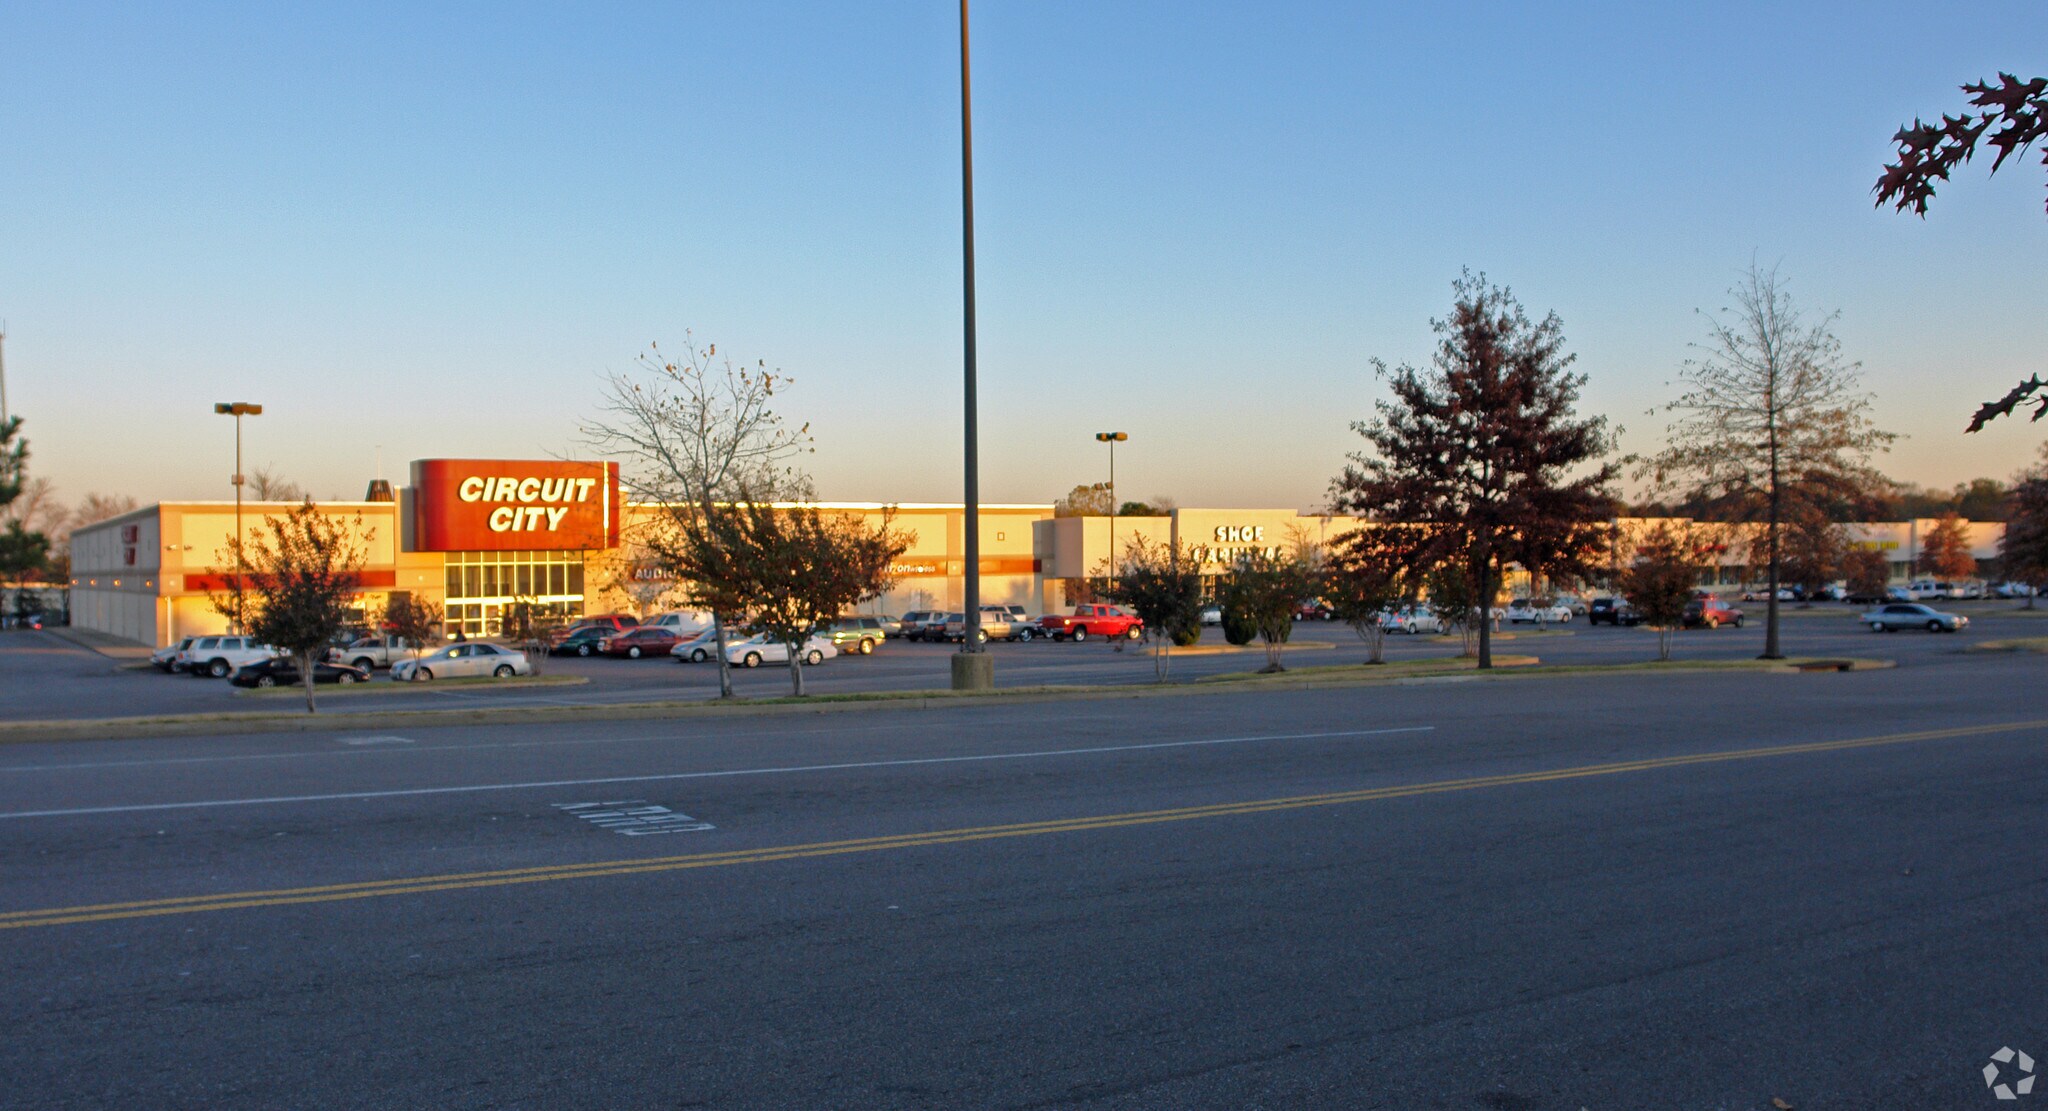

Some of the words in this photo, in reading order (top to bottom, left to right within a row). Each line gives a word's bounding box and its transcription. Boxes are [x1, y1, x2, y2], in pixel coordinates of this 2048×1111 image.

[459, 476, 596, 503] CIRCUIT
[488, 506, 569, 532] CITY
[1215, 526, 1264, 542] SHOE
